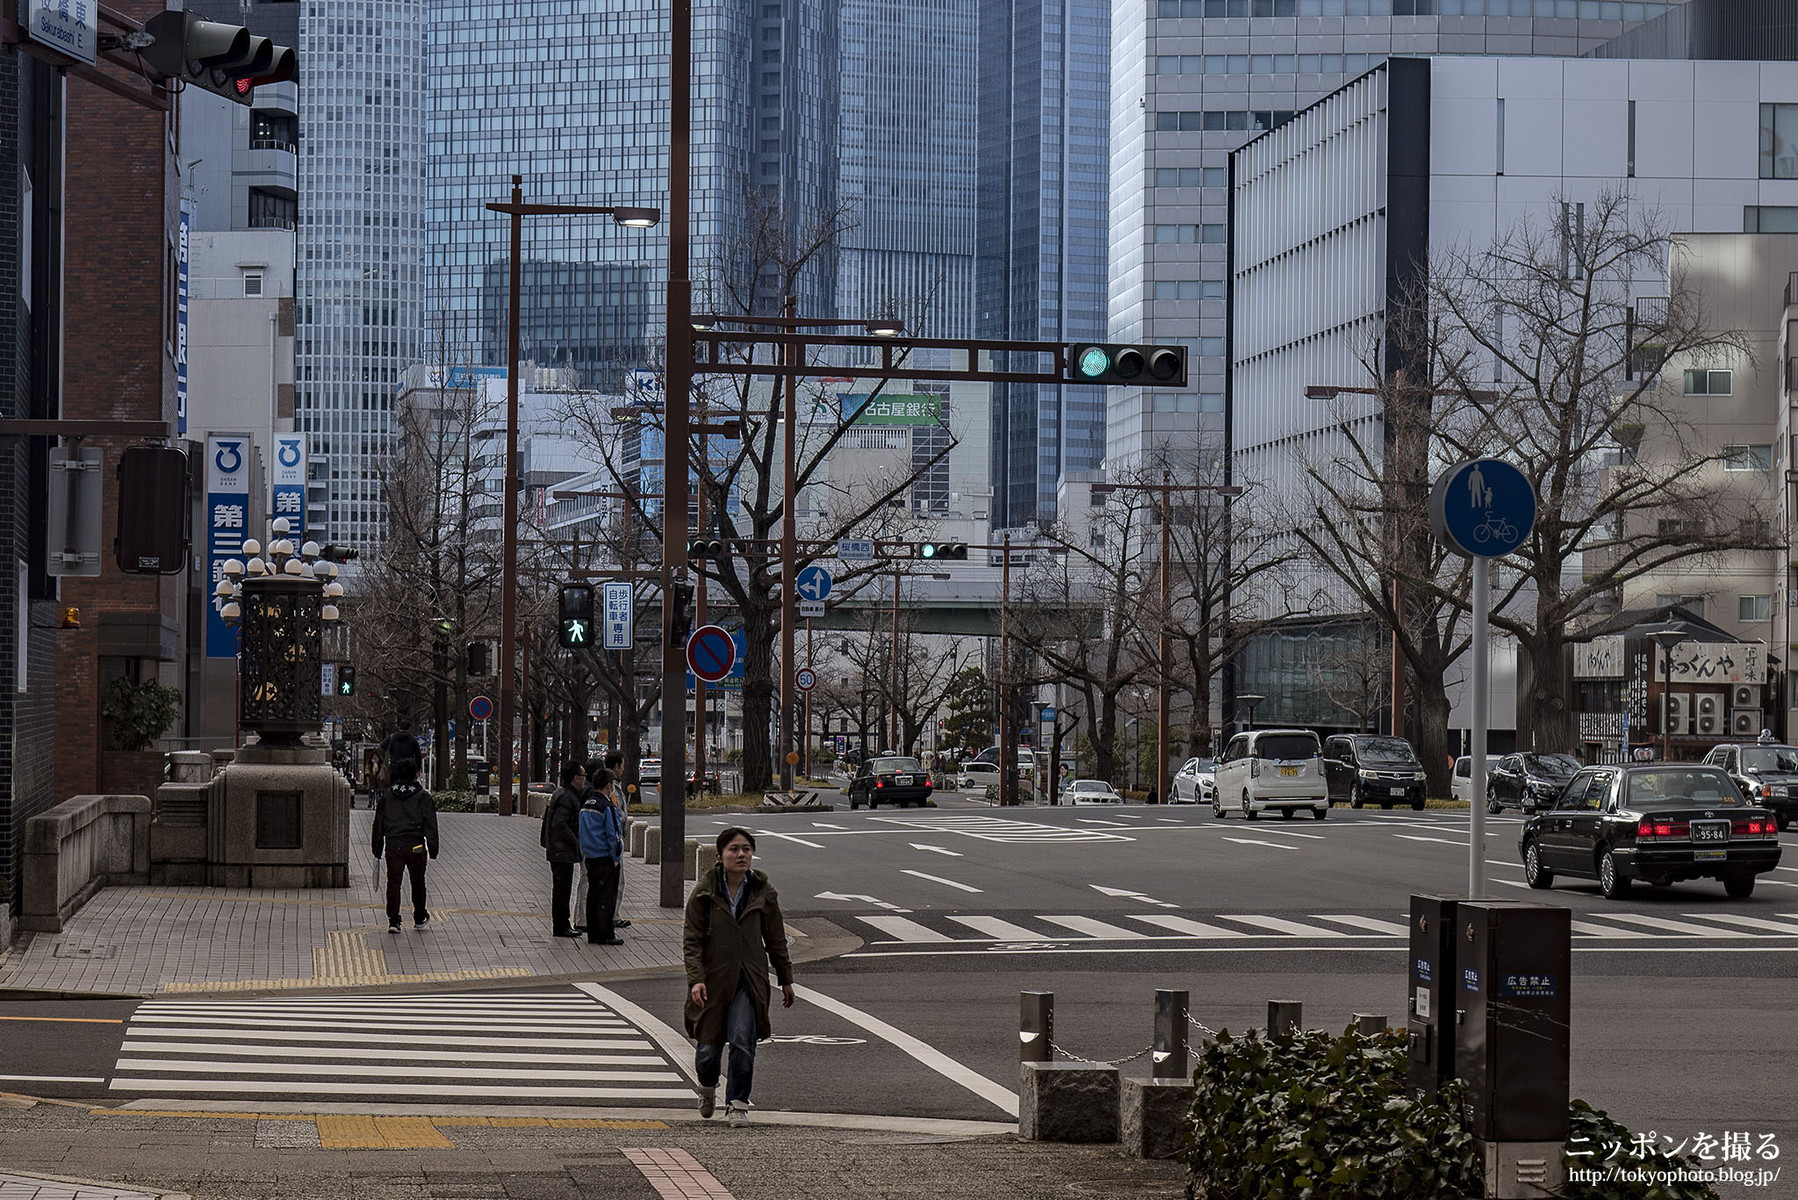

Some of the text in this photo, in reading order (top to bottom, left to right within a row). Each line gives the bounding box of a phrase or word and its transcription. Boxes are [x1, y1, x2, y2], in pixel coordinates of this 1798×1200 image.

[41, 16, 84, 49] Sakurabashi E
[865, 402, 936, 417] 名古屋銀行
[841, 542, 870, 552] 桜橋西
[609, 589, 618, 621] 自転車
[619, 589, 628, 622] 歩行者
[613, 623, 624, 645] 専用
[1744, 646, 1757, 682] 下町の味
[799, 674, 813, 685] 50
[1701, 830, 1724, 840] 95-84
[1507, 976, 1551, 986] 広告禁止
